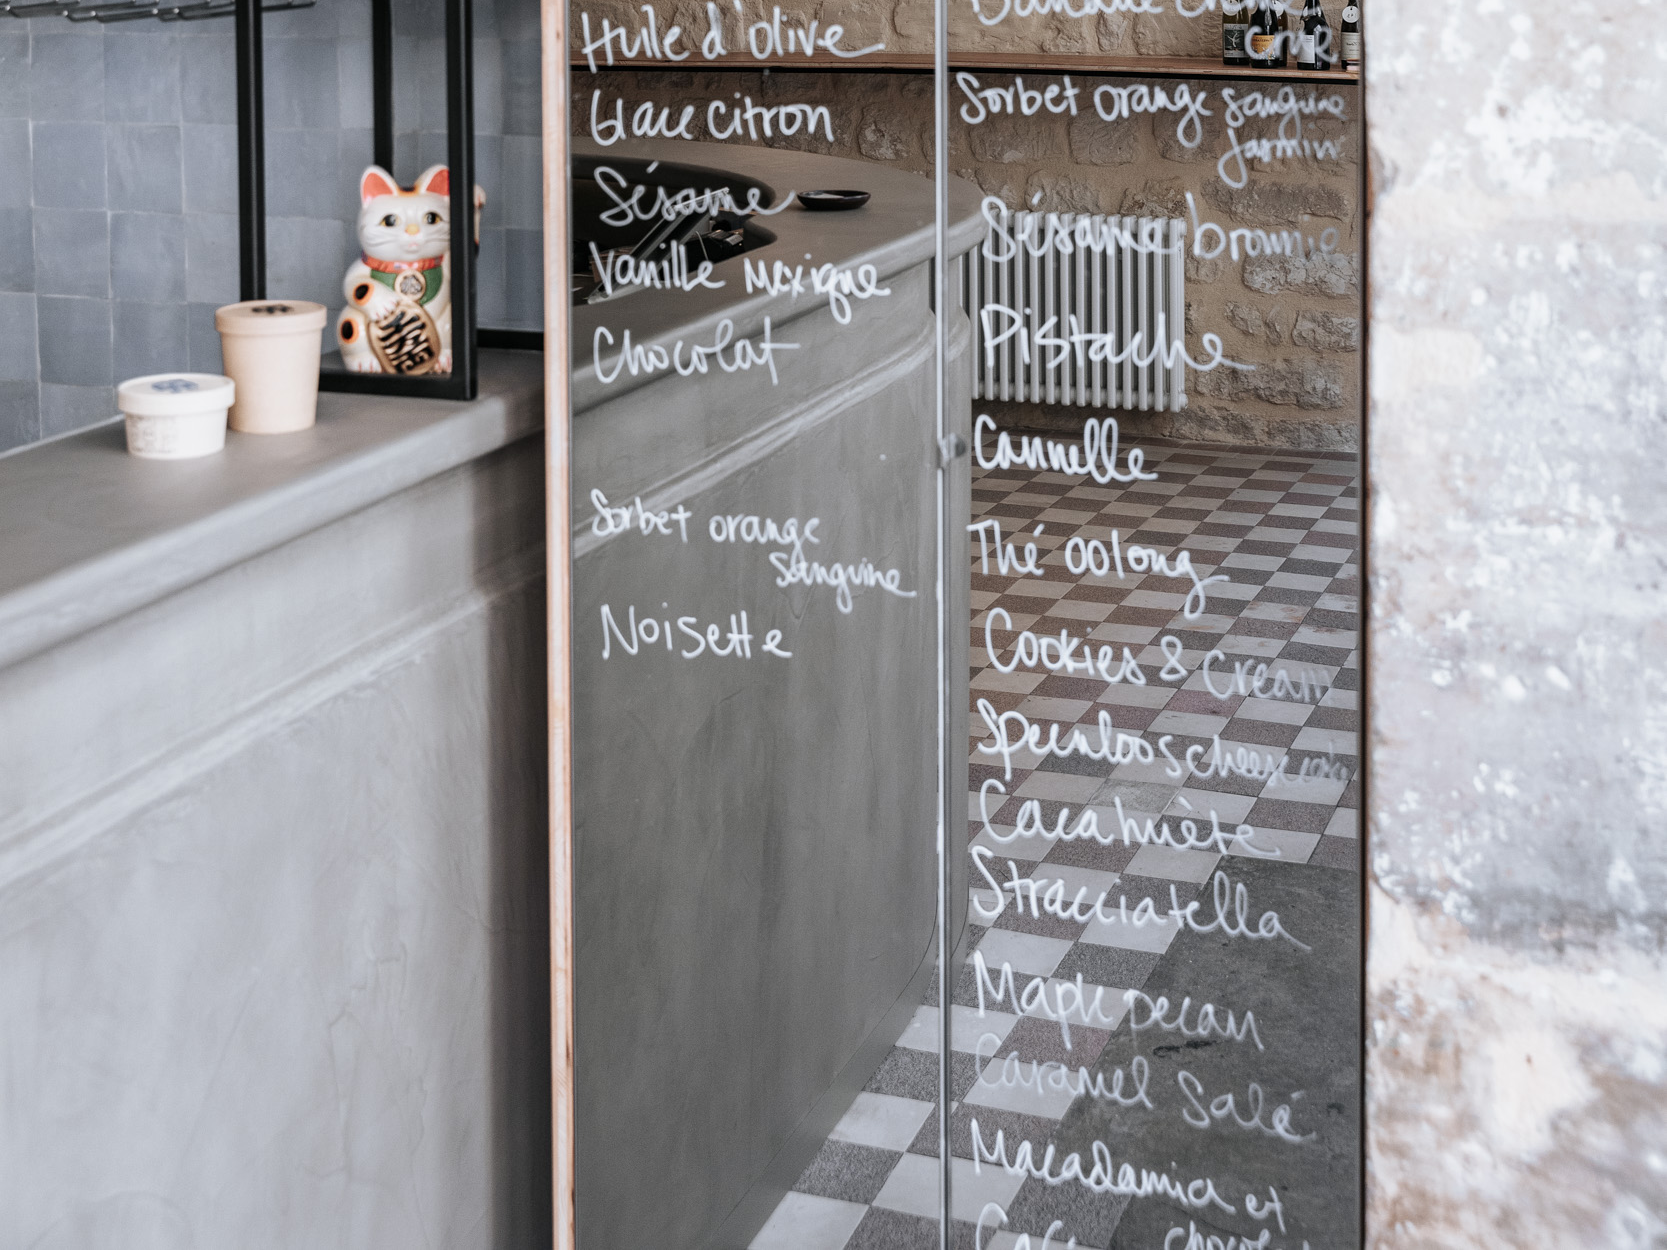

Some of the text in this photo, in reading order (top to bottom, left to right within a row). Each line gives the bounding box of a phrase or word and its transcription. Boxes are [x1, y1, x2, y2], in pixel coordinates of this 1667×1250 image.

[581, 4, 691, 74] Huile
[707, 92, 834, 143] citron
[956, 71, 1082, 124] Sorbet
[1093, 83, 1214, 149] orange
[594, 161, 797, 227] Sésame
[589, 240, 727, 296] Vanille
[593, 315, 801, 386] Chocolat
[980, 303, 1256, 371] Pistache
[974, 414, 1158, 484] Cannelle
[590, 488, 820, 568] Sorbet orange
[966, 519, 1230, 620] Thé oolong
[600, 603, 793, 660] Noisette
[985, 607, 1147, 685] Cookies
[1160, 635, 1187, 681] &
[971, 845, 1312, 950] Stracciatella
[976, 1033, 1153, 1110] Caramel
[971, 1117, 1288, 1234] Macadamia et
